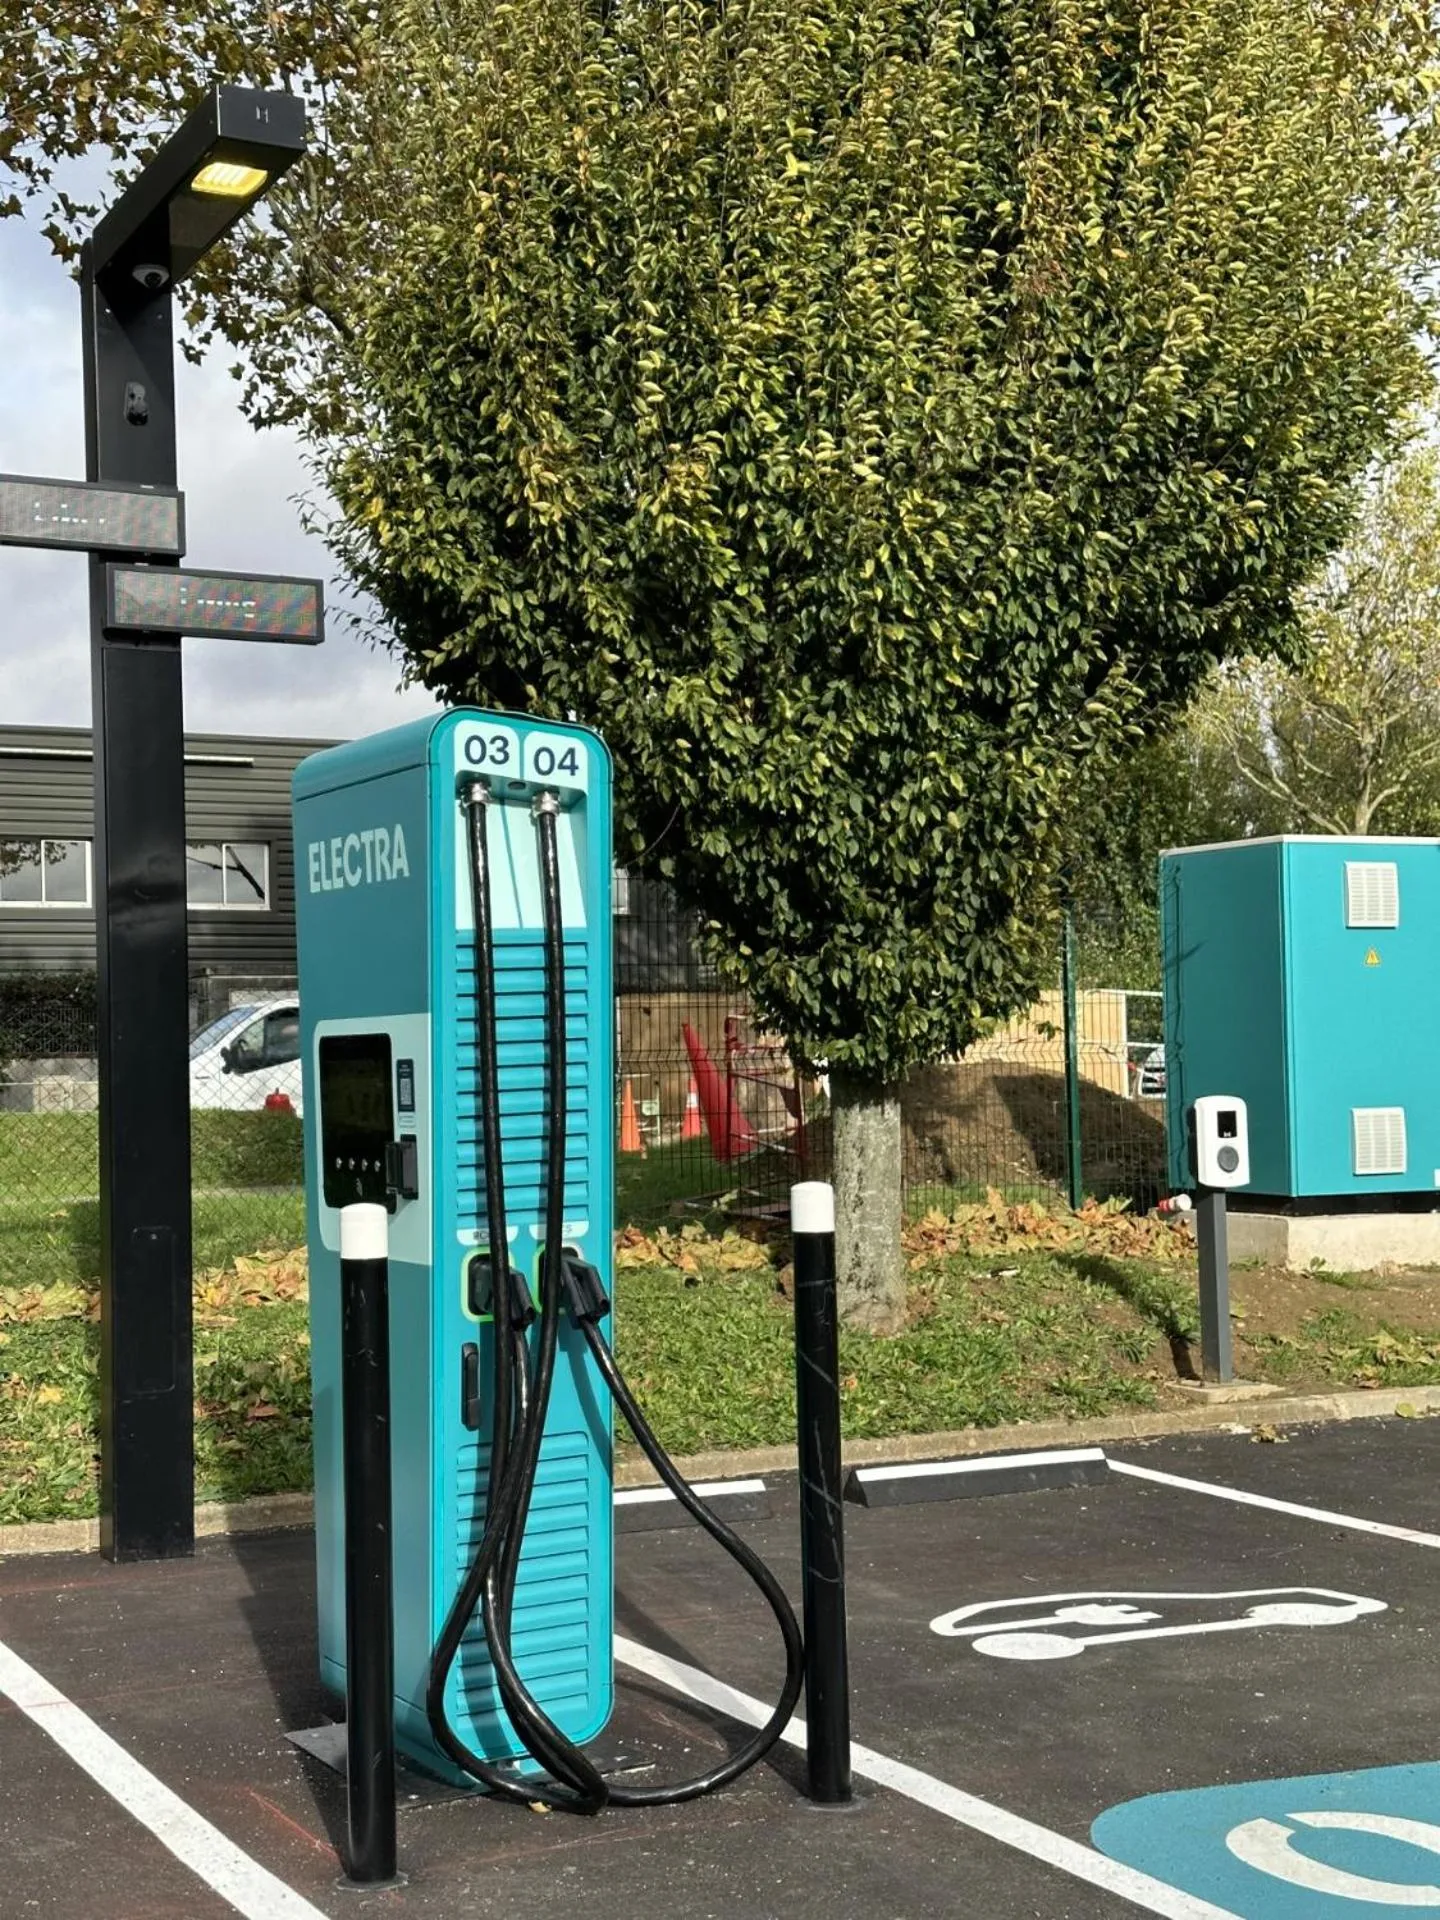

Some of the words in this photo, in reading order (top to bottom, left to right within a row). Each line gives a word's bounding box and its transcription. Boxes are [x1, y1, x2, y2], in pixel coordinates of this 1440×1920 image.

[464, 735, 510, 765] 03
[533, 746, 579, 776] 04
[308, 823, 410, 893] ELECTRA
